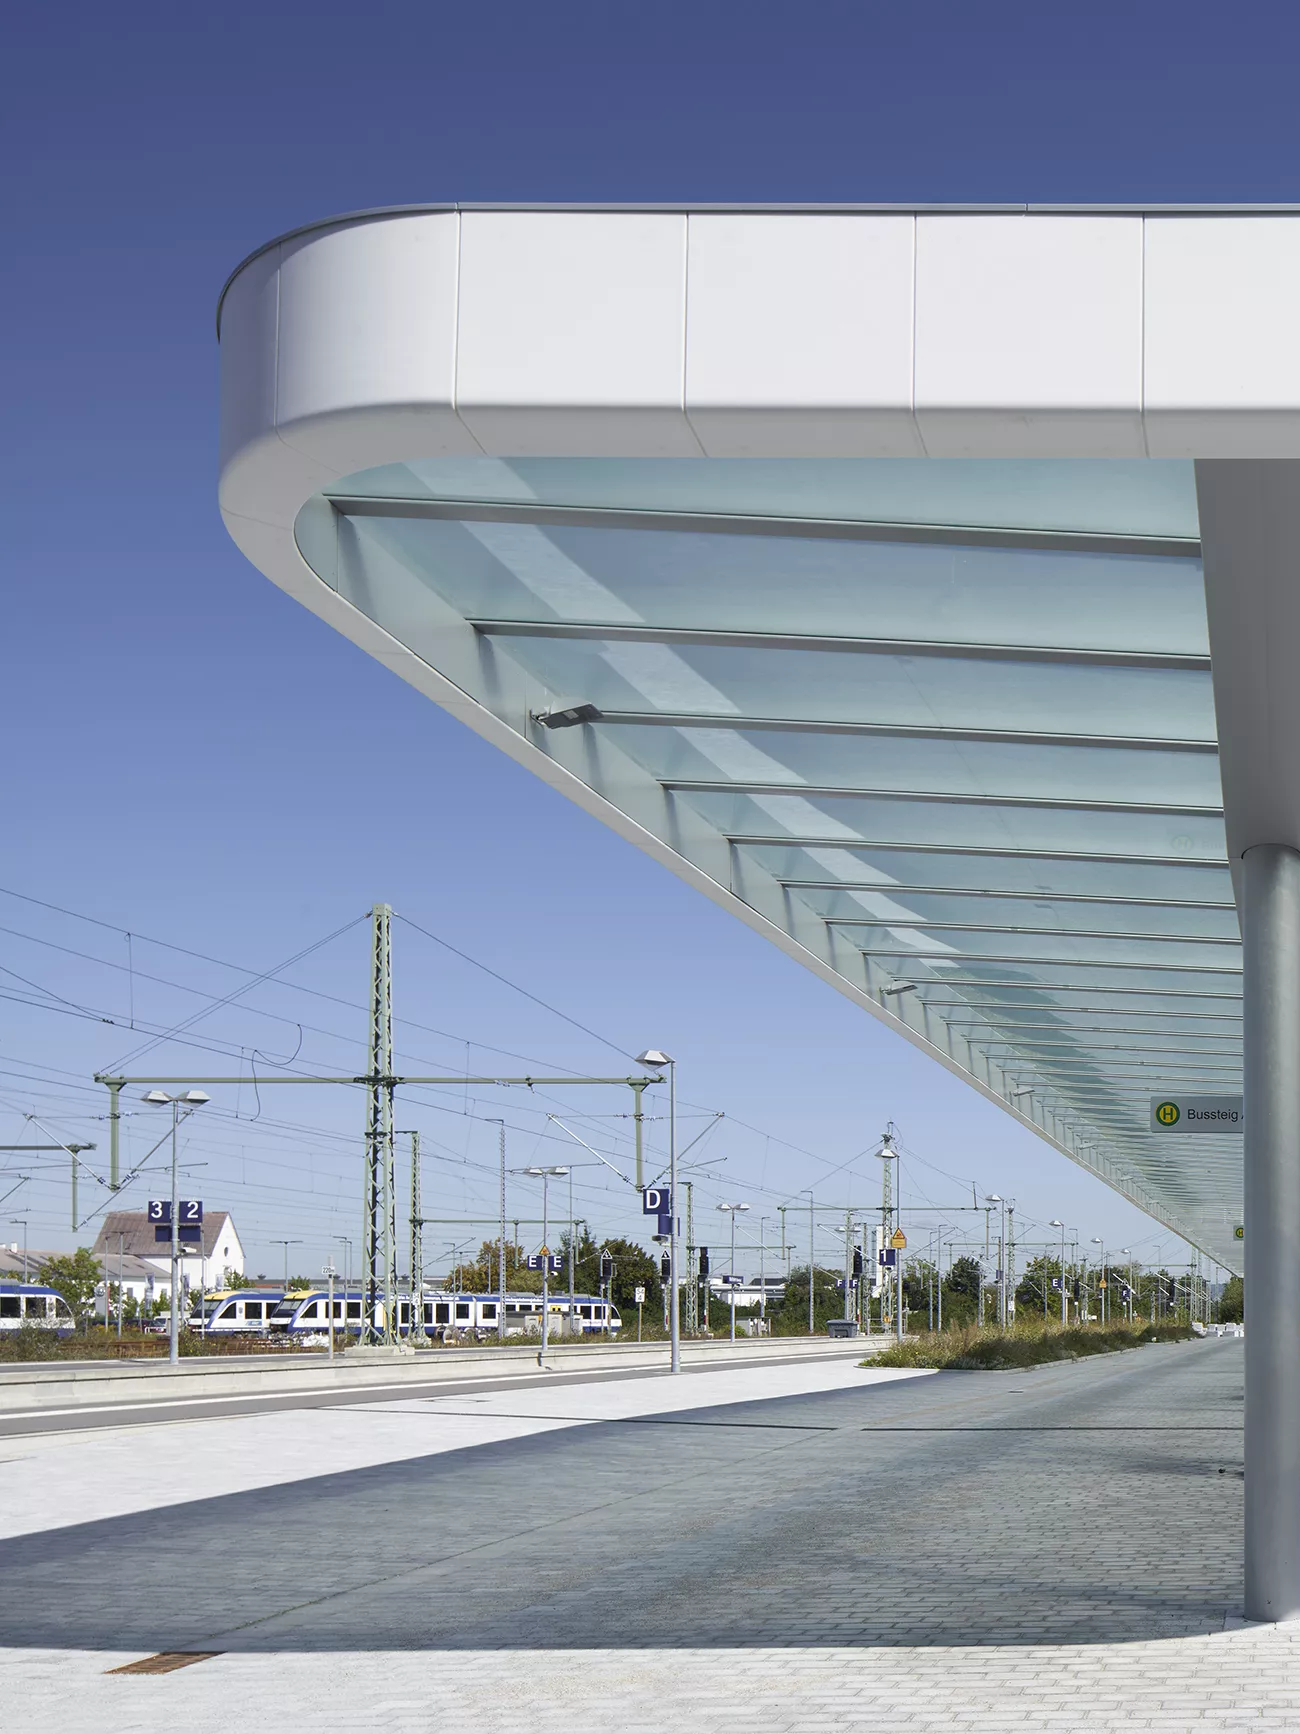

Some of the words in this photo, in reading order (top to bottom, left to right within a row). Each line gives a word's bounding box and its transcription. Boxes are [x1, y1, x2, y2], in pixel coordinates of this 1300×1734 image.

[1162, 1107, 1174, 1120] H
[1187, 1108, 1239, 1123] Bussteig
[646, 1189, 661, 1209] D
[150, 1201, 163, 1219] 3
[186, 1201, 199, 1219] 2
[528, 1255, 537, 1268] E
[553, 1255, 562, 1268] E
[880, 1249, 887, 1262] 1
[837, 1279, 843, 1287] F
[852, 1279, 858, 1287] F
[1052, 1278, 1059, 1287] E
